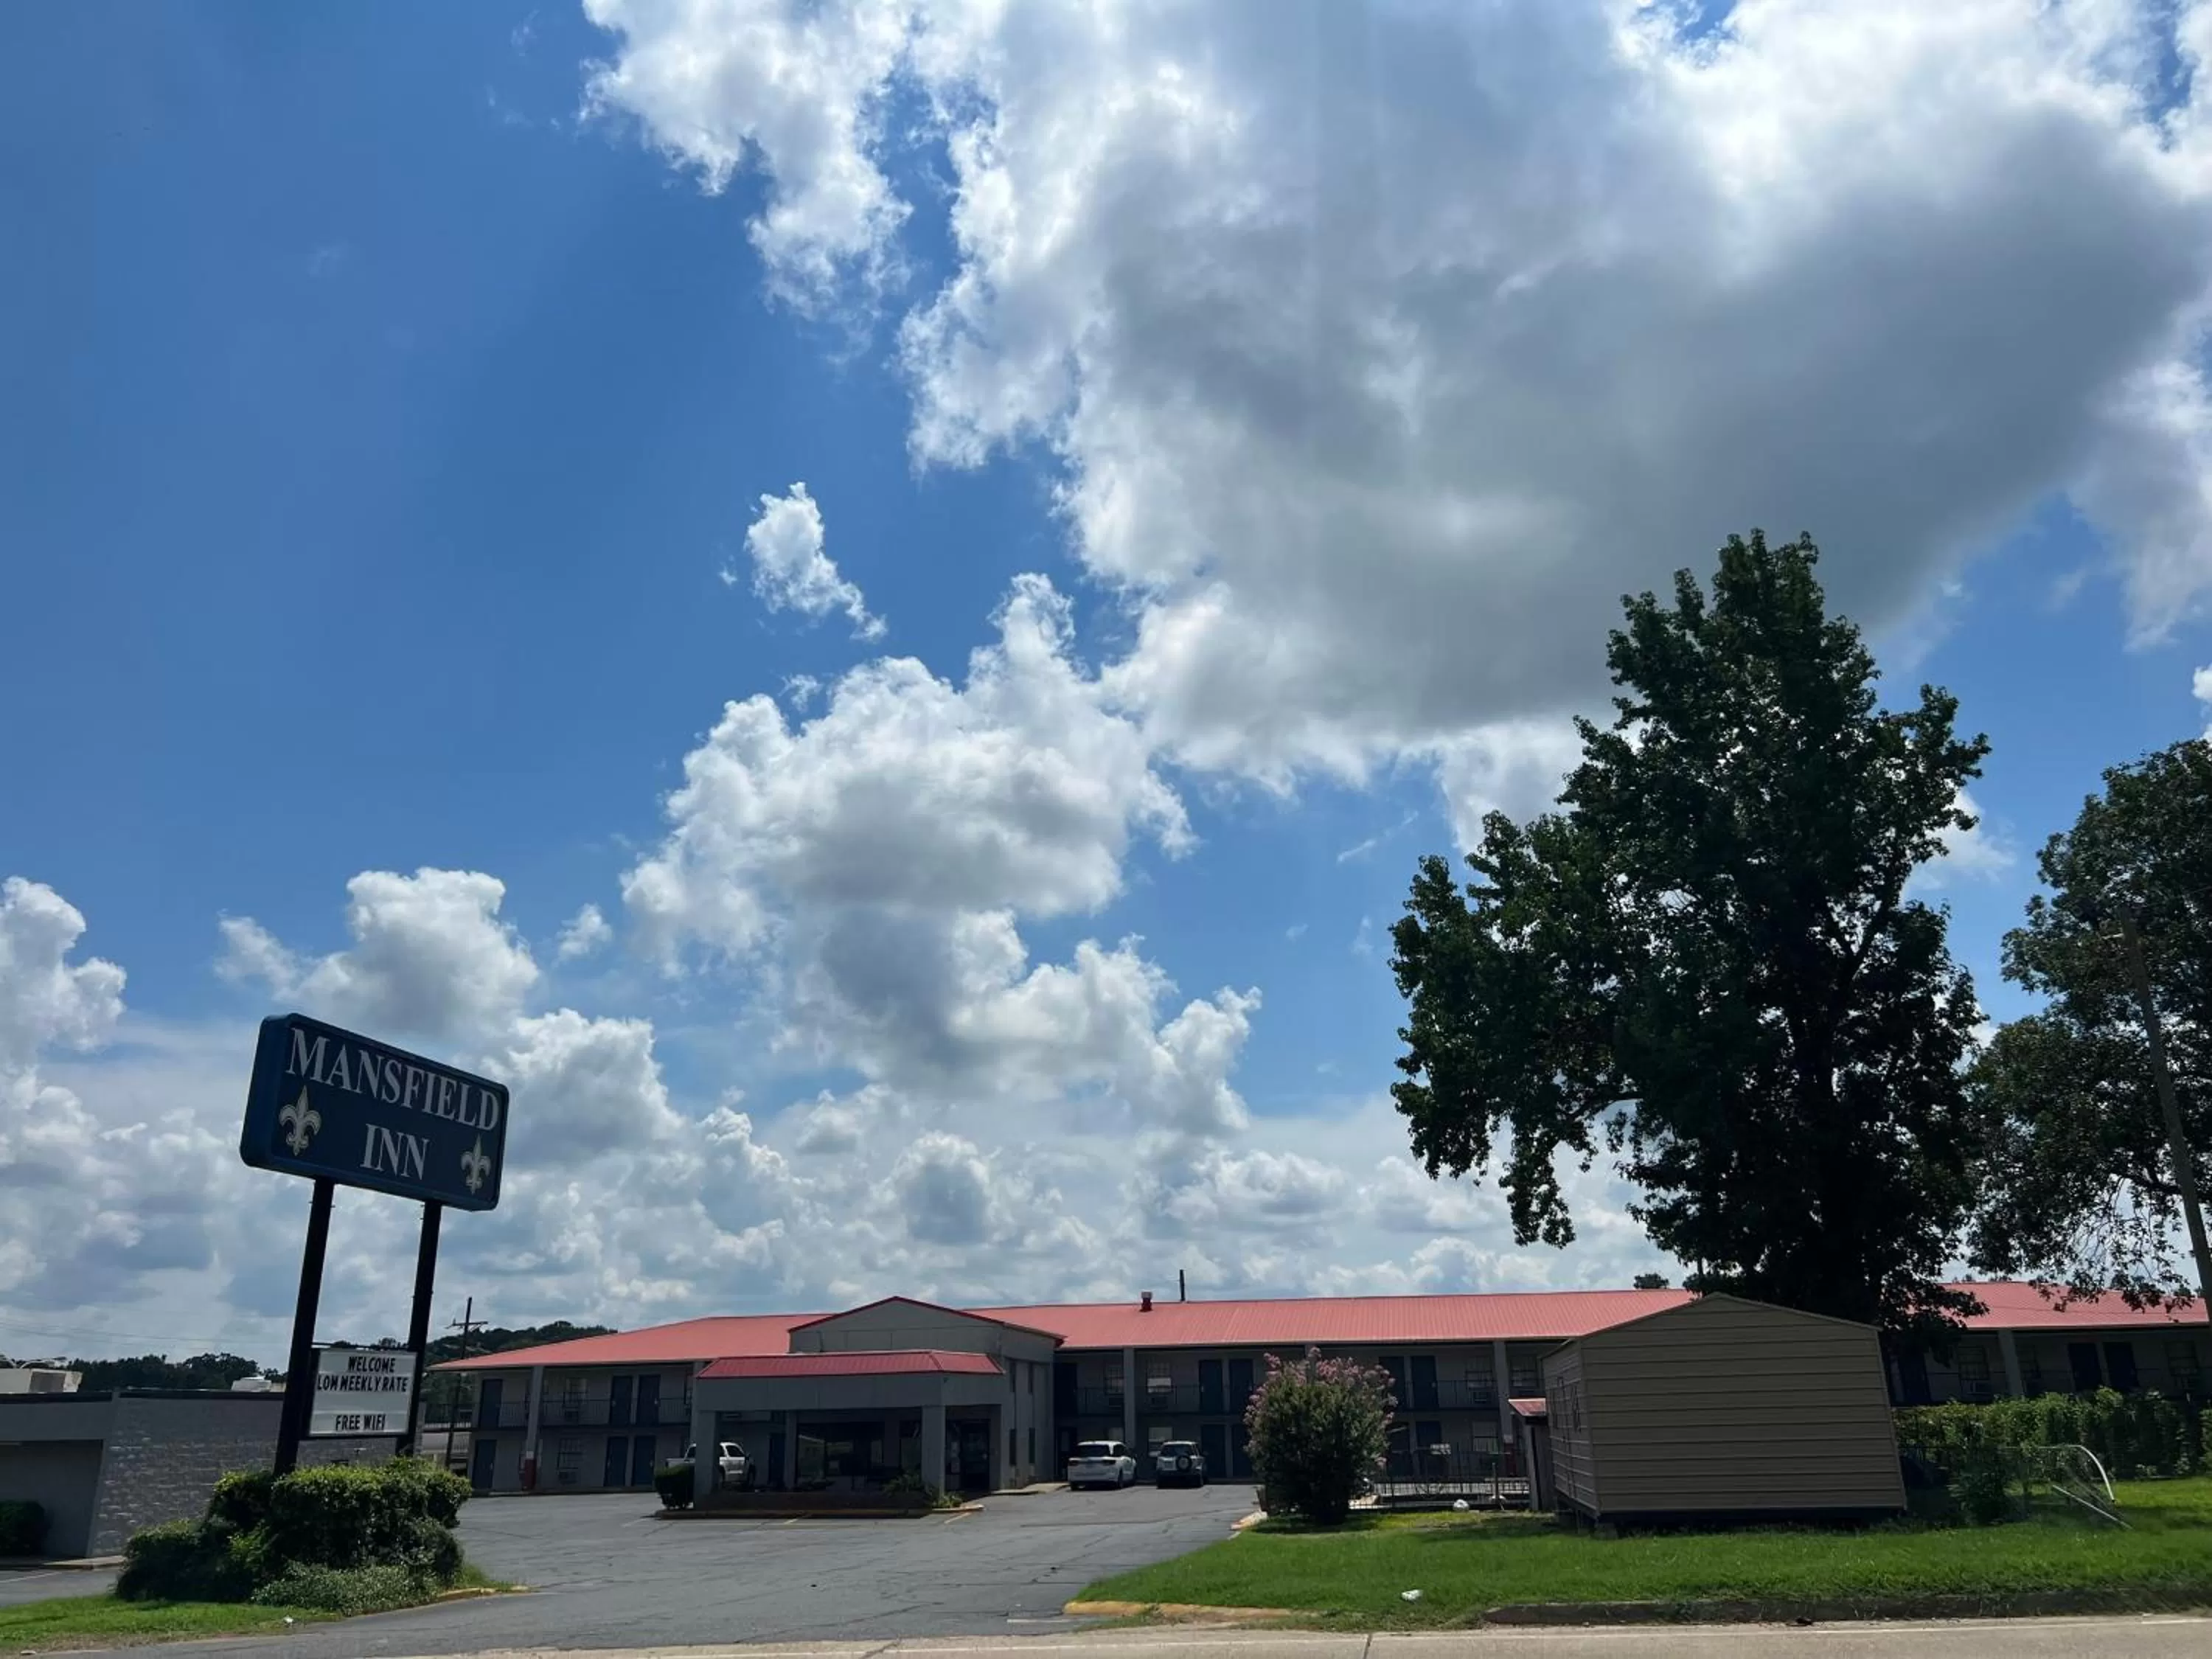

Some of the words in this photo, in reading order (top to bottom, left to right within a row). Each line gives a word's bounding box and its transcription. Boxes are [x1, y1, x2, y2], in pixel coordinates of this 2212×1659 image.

[285, 1028, 500, 1131] MANSFIELD
[359, 1123, 429, 1180] INN
[348, 1356, 396, 1373] WELCOME
[381, 1377, 408, 1392] RATE
[335, 1414, 361, 1430] FREE
[364, 1413, 386, 1430] WIFI
